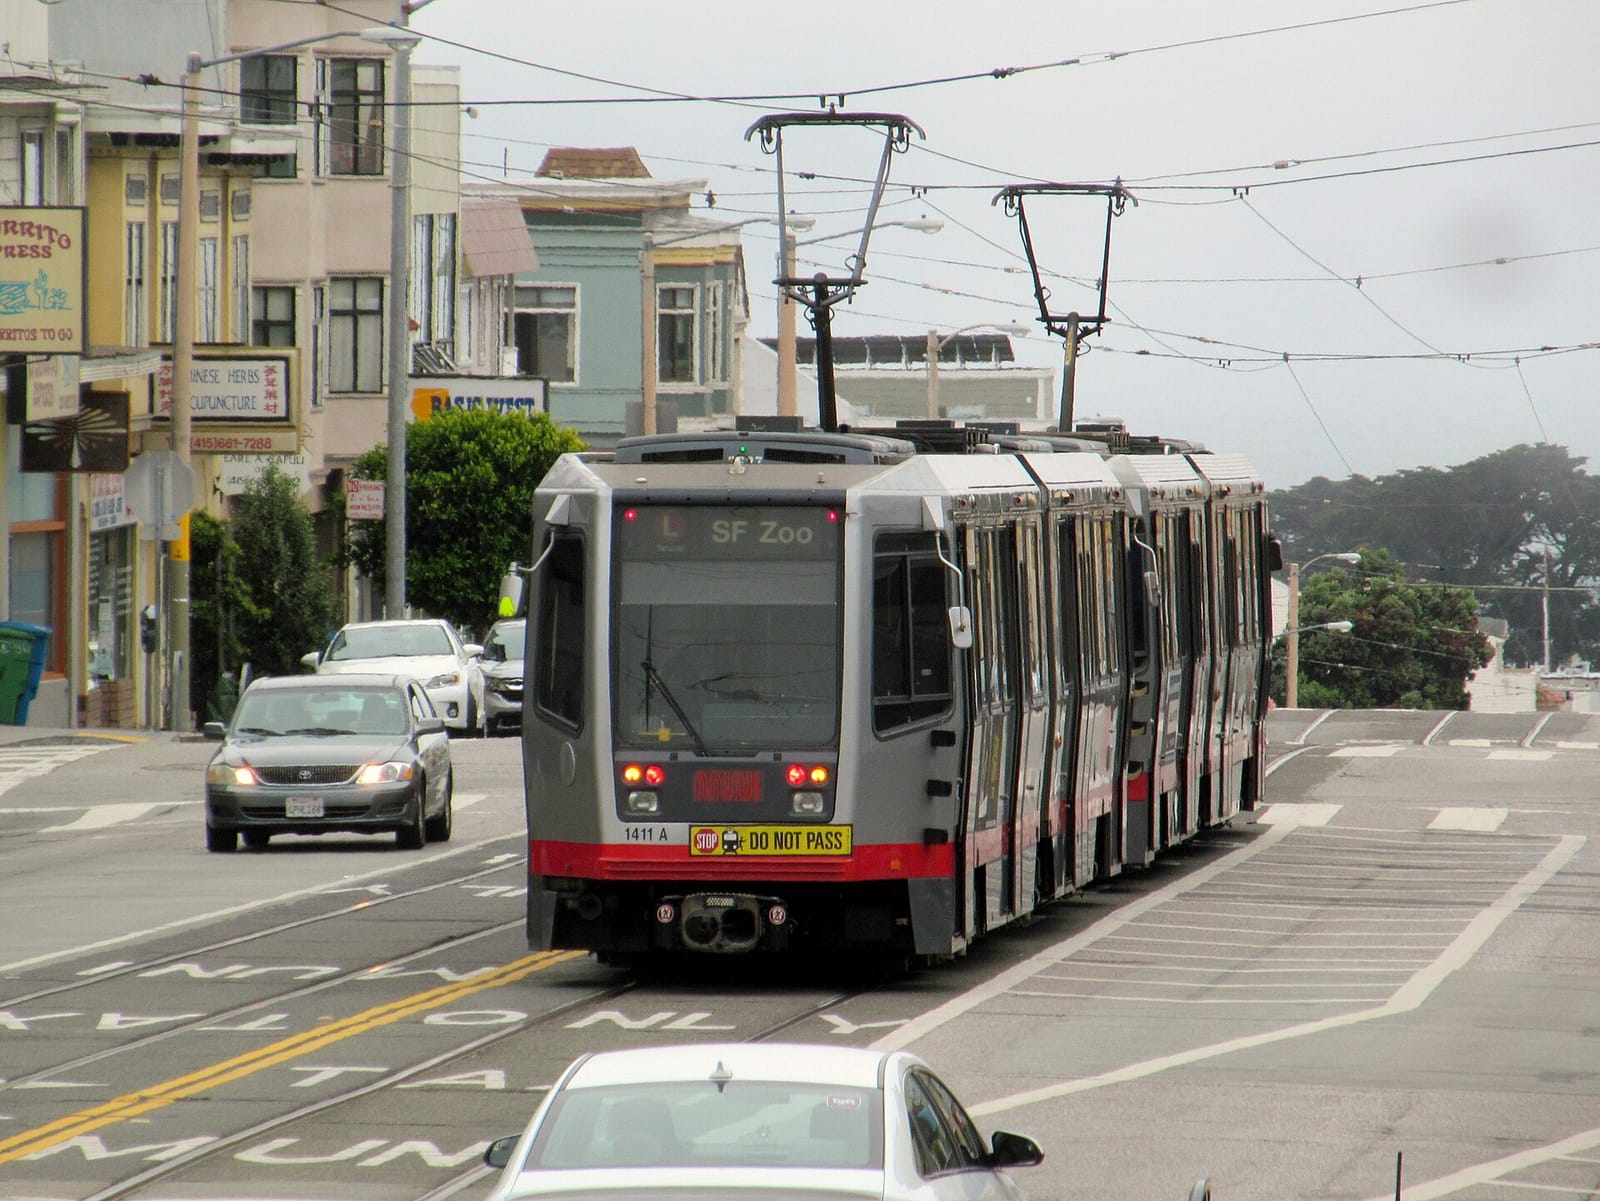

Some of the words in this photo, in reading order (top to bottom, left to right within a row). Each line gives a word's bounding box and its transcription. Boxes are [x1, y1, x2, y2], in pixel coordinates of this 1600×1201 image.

[0, 219, 72, 250] RRITO
[0, 244, 52, 259] RESS
[0, 328, 37, 341] RRITOS
[40, 328, 55, 341] TO
[58, 328, 73, 341] GO
[191, 369, 220, 384] INESE
[227, 368, 260, 384] HERBS
[190, 395, 257, 411] CUPUNCTURE
[663, 514, 679, 537] L
[711, 519, 747, 543] SF
[759, 521, 813, 544] Zoo
[625, 827, 653, 841] 1411
[659, 827, 668, 841] A
[696, 833, 718, 849] STOP
[749, 831, 769, 850] DO
[774, 831, 802, 850] NOT
[806, 831, 843, 850] PASS
[424, 1010, 908, 1035] ONLY
[17, 1136, 494, 1167] MUN
